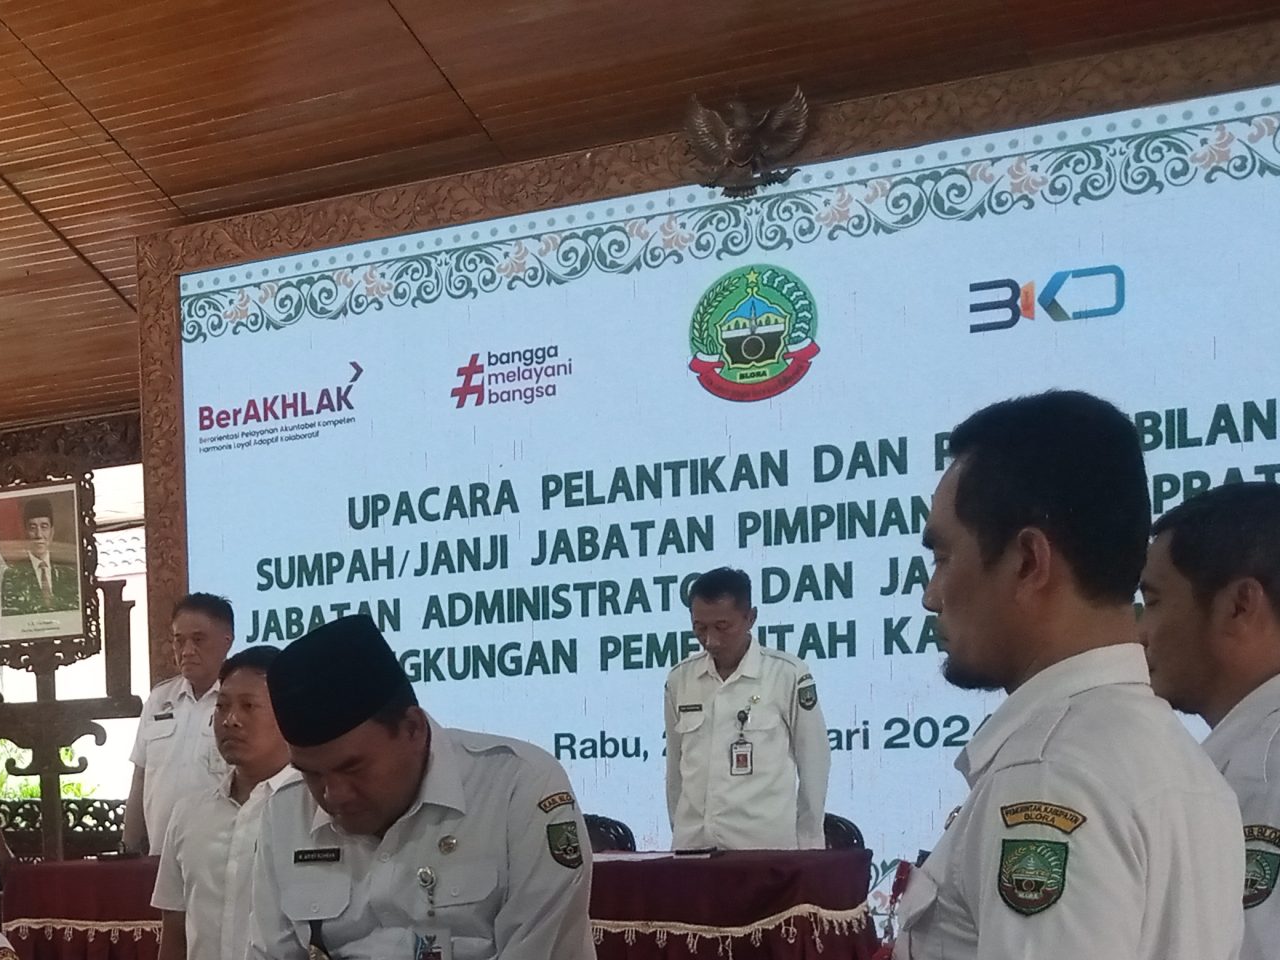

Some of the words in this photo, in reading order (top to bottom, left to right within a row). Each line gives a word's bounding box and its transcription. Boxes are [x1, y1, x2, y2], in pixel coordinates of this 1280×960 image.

[487, 345, 558, 366] bangga
[488, 358, 572, 385] melayani
[198, 384, 354, 431] BerAKHLAK
[488, 384, 556, 404] bangsa
[348, 479, 520, 530] UPACARA
[541, 449, 788, 510] PELANTIKAN
[813, 436, 908, 483] DAN
[1133, 398, 1277, 452] BILAN
[256, 534, 508, 591] SUMPAH/JANJI
[531, 515, 714, 566] JABATAN
[422, 572, 705, 629] ADMINISTRATO
[761, 561, 853, 604] DAN
[398, 638, 577, 682] GKUNGAN
[554, 730, 649, 762] Rabu,
[827, 720, 870, 751] ari
[883, 714, 992, 750] 202
